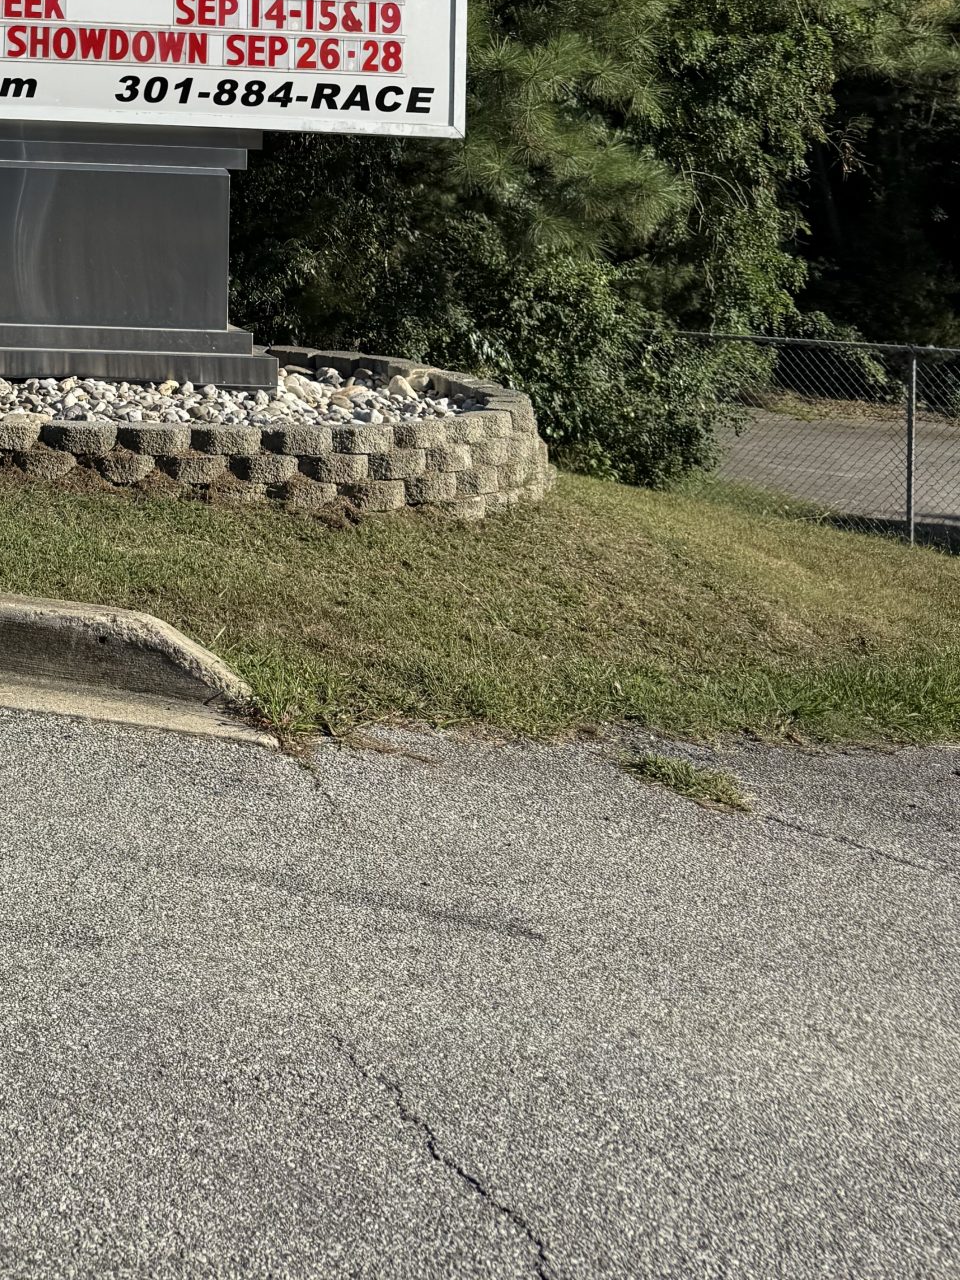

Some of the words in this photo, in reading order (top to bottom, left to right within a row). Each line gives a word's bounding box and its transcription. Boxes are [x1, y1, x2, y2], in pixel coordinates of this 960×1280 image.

[7, 25, 208, 65] SHOWDOWN
[226, 34, 288, 67] SEP
[115, 74, 435, 114] 301-884-RACE
